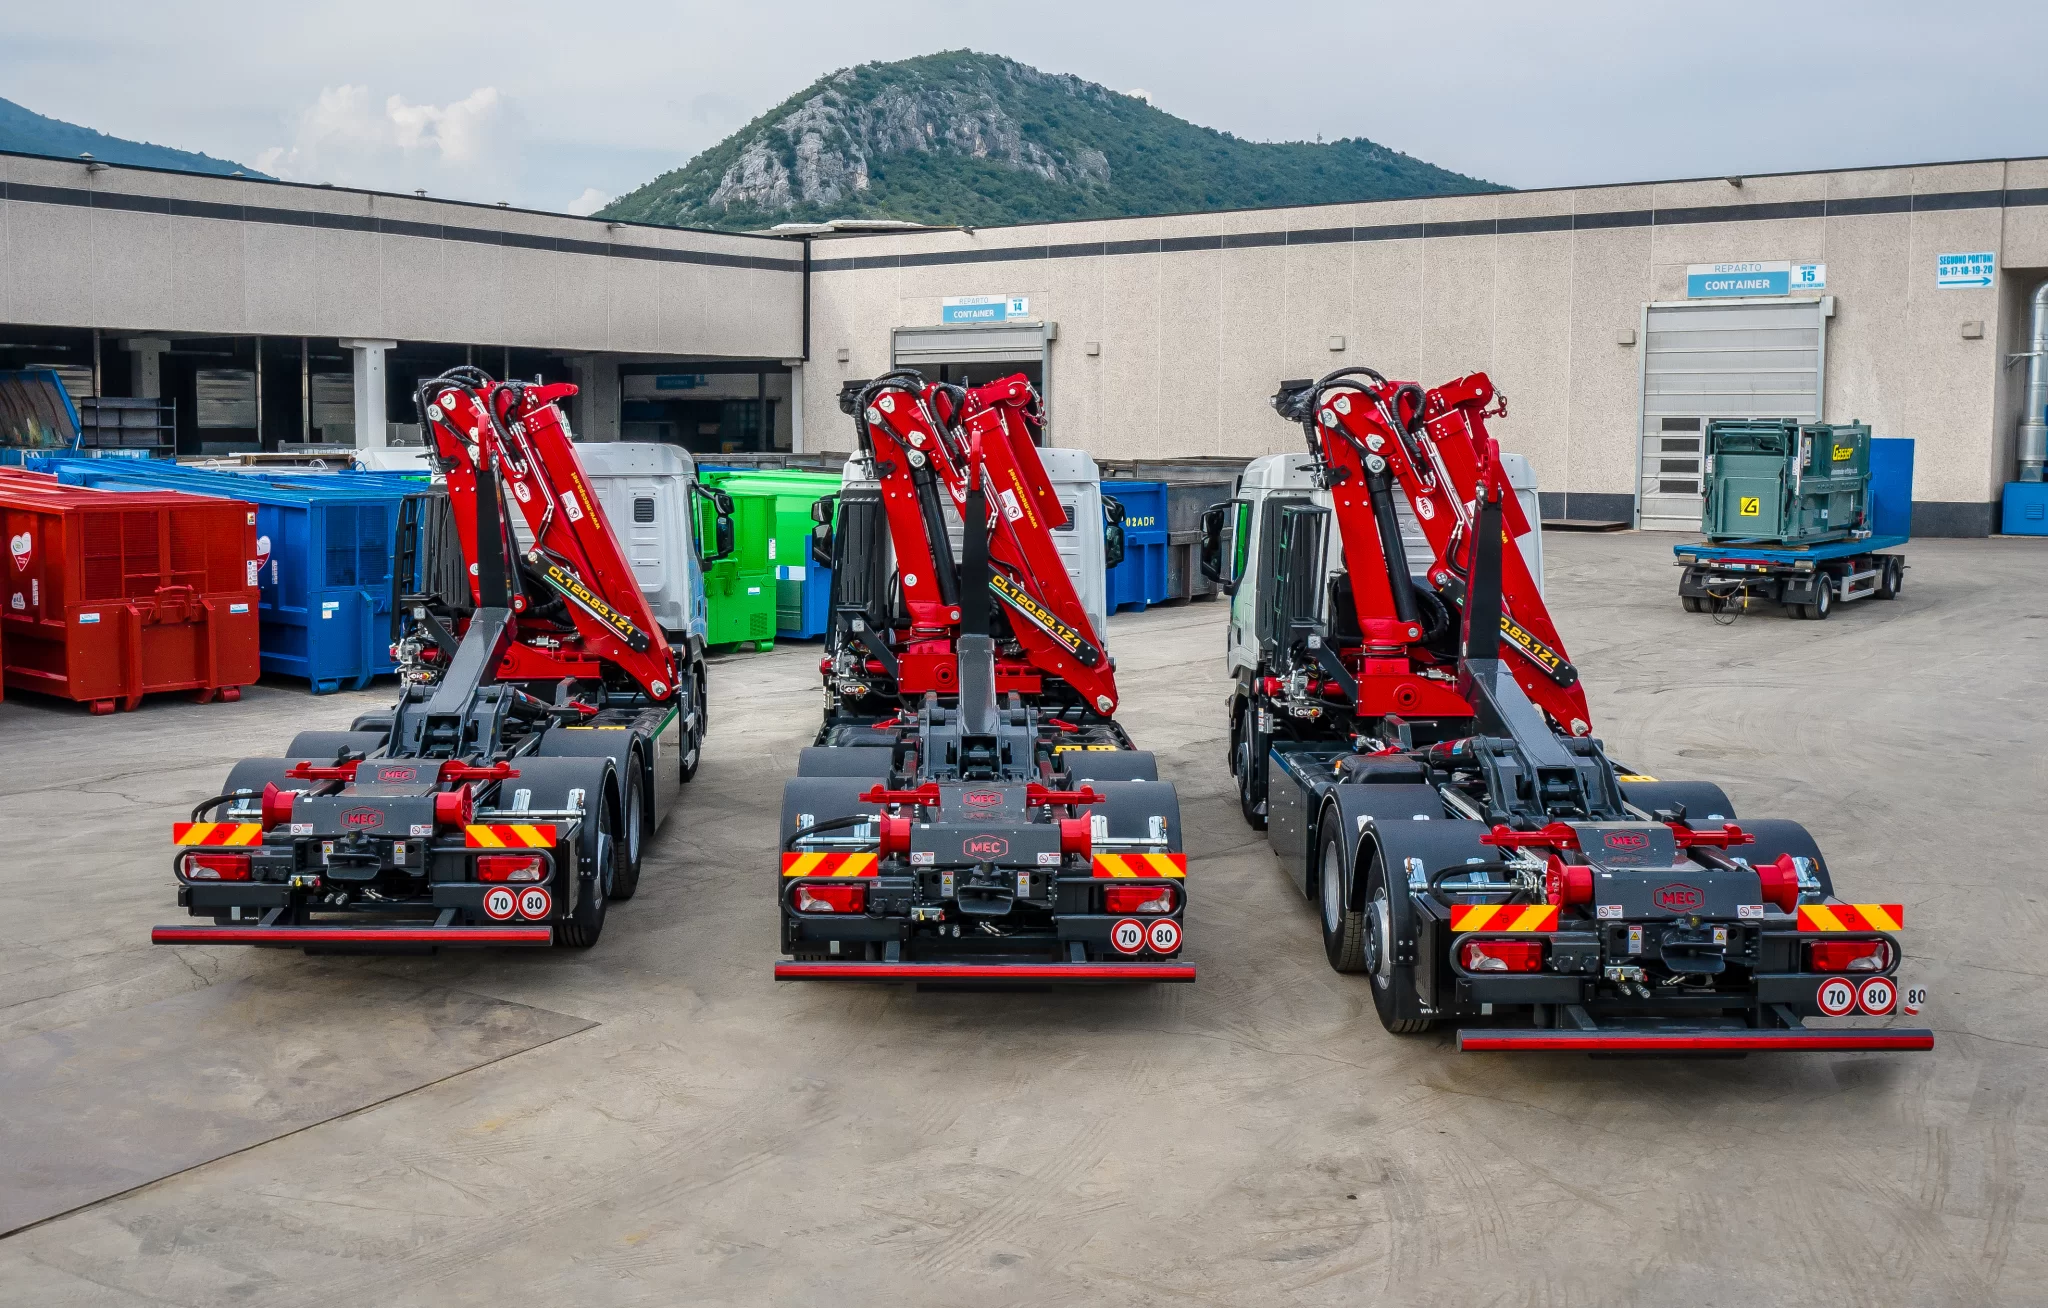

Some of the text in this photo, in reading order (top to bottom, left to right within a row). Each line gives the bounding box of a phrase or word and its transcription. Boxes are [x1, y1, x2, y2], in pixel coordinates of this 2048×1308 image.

[1939, 254, 1993, 265] SEGUONO PORTONI
[1715, 264, 1762, 273] REPARTO
[1939, 265, 1993, 276] 16-17-18-19-20
[1801, 271, 1815, 282] 15
[1705, 279, 1770, 291] CONTAINER
[959, 297, 989, 305] REPARTO
[1013, 303, 1022, 311] 14
[953, 309, 994, 318] CONTAINER
[517, 483, 527, 499] MEC
[1420, 499, 1430, 515] MEC
[1744, 499, 1757, 513] G
[1500, 617, 1560, 668] 0.83.1Z1
[384, 770, 410, 778] MEC
[970, 794, 996, 803] MEC
[348, 813, 376, 825] MEC
[1611, 836, 1641, 845] MEC
[971, 842, 1000, 853] MEC
[493, 897, 542, 910] 70 80
[1662, 892, 1696, 905] MEC
[1121, 930, 1173, 943] 70 80
[1828, 989, 1926, 1005] 70 80 80
